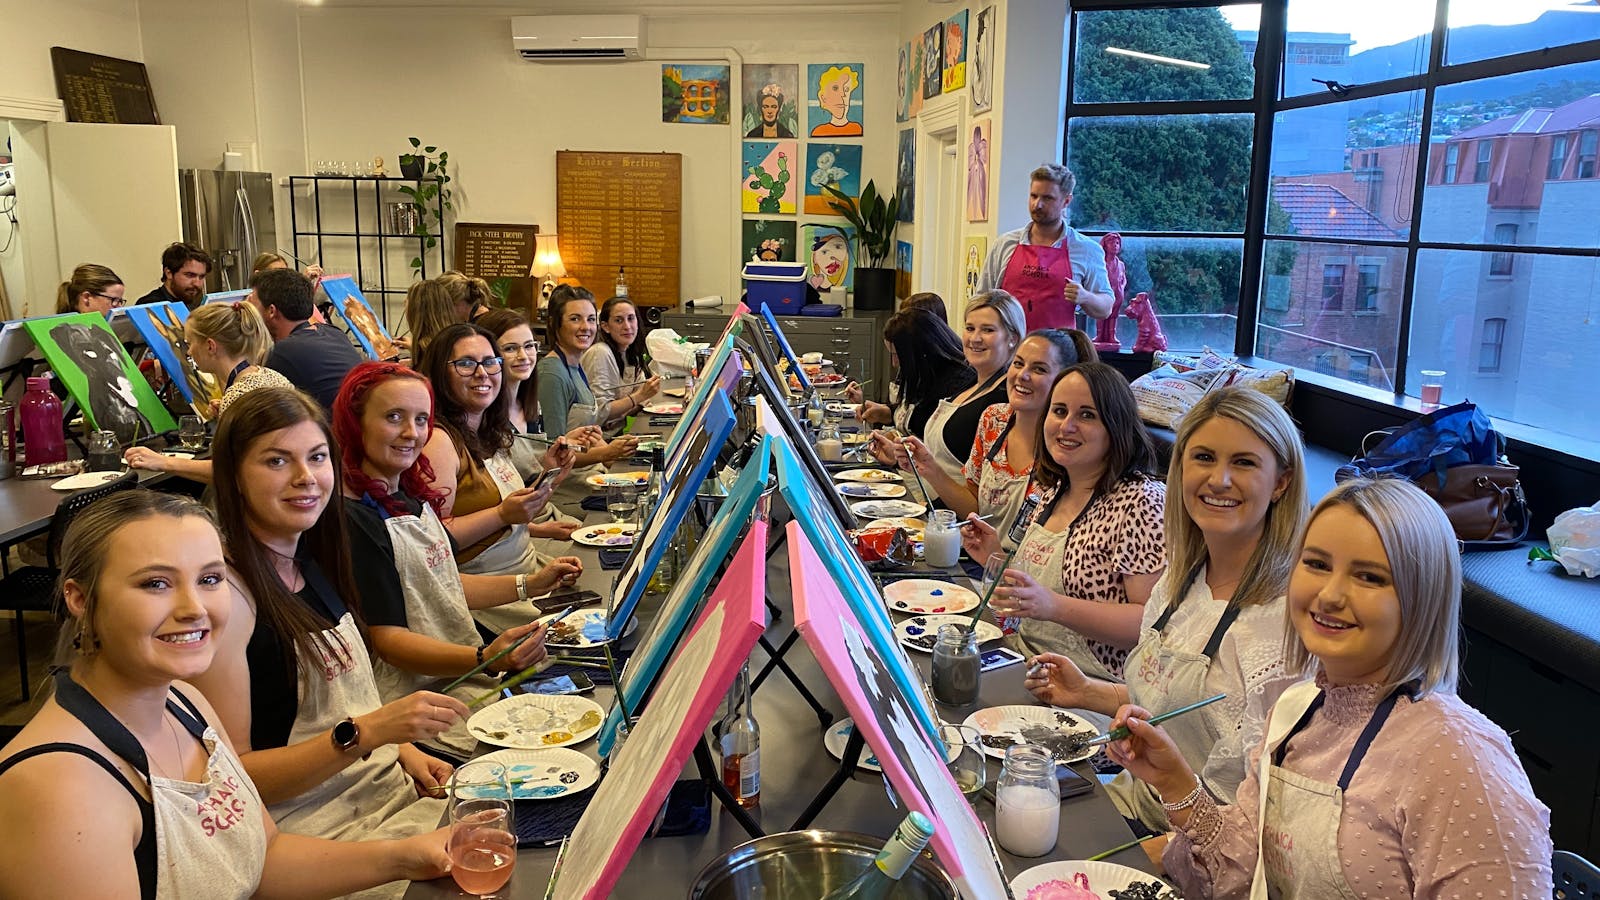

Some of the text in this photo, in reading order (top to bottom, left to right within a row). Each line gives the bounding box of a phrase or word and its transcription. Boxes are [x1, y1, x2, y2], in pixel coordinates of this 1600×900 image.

[577, 156, 660, 167] Ladies Section
[503, 231, 524, 239] TROPHY
